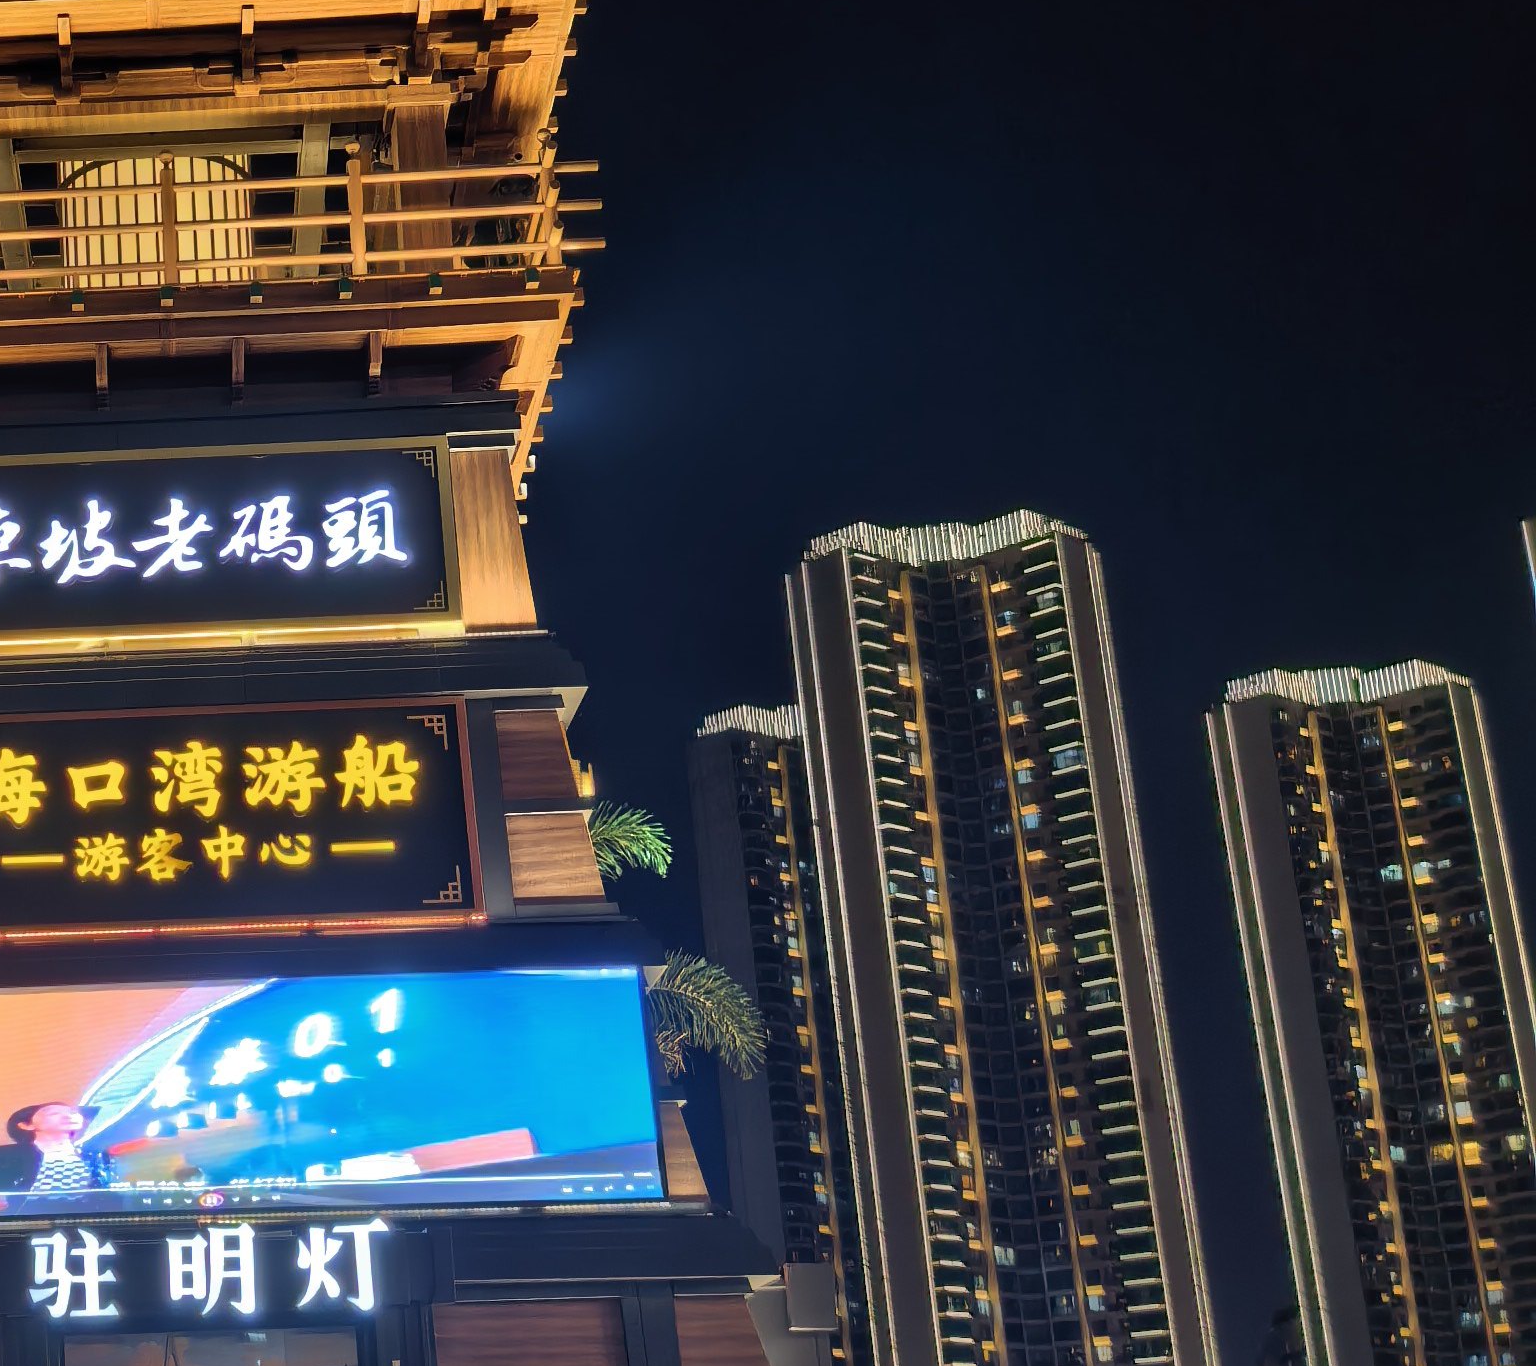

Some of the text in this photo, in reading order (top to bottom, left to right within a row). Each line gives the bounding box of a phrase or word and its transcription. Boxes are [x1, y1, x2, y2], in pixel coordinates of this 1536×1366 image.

[73, 827, 314, 883] 游客中心
[29, 1216, 390, 1321] 驻明灯
